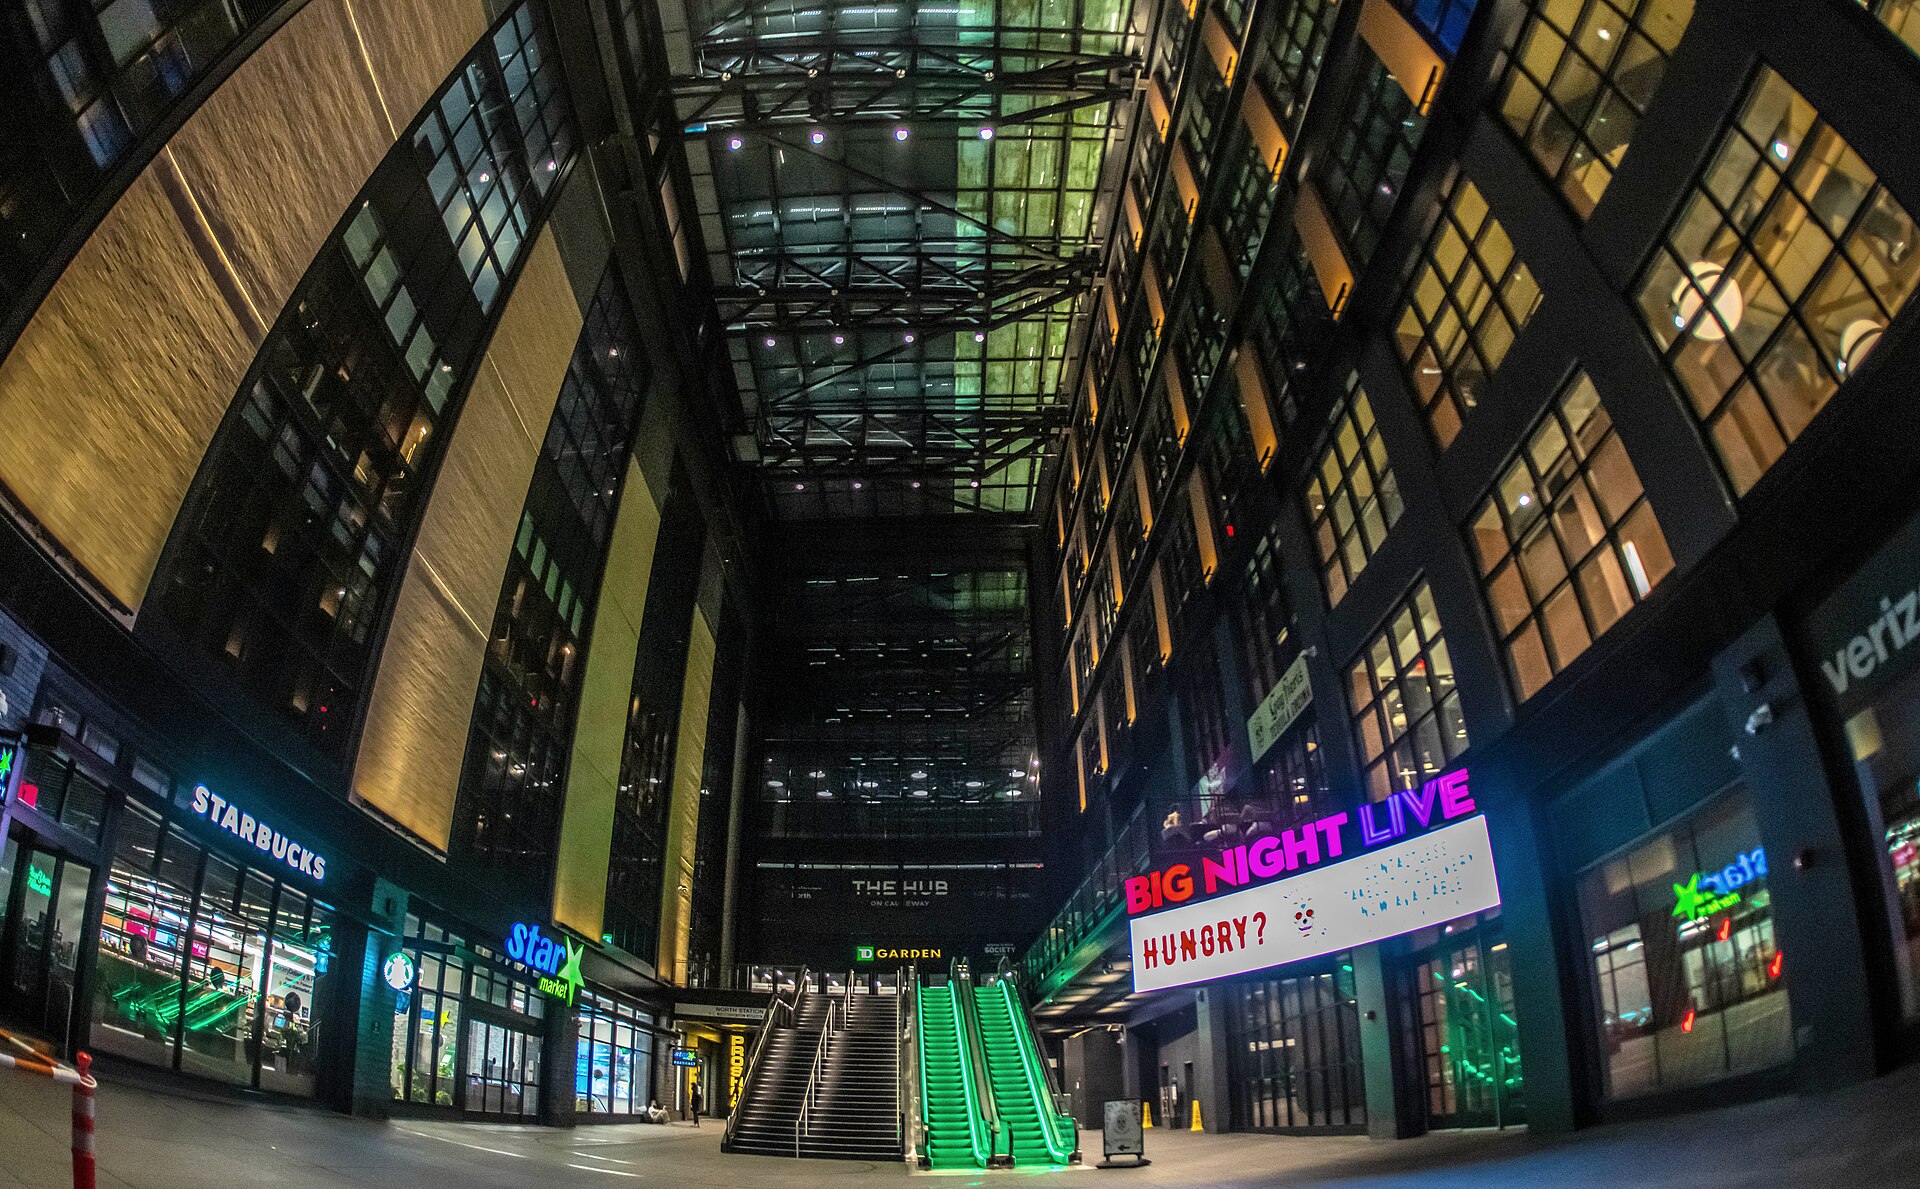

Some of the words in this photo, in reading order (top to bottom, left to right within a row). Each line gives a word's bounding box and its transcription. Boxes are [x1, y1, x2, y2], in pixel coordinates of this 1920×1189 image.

[1821, 587, 1920, 694] veriz
[192, 784, 326, 880] STARBUCKS
[1125, 864, 1195, 915] BIG
[1203, 811, 1348, 894] NIGHT
[1358, 767, 1476, 846] LIVE
[852, 880, 897, 896] THE
[903, 880, 949, 896] HUB
[984, 946, 1016, 954] SOCIETY
[1142, 911, 1268, 970] HUNGRY?
[876, 948, 942, 959] GARDEN
[539, 976, 568, 999] market
[716, 1006, 738, 1014] NORTH
